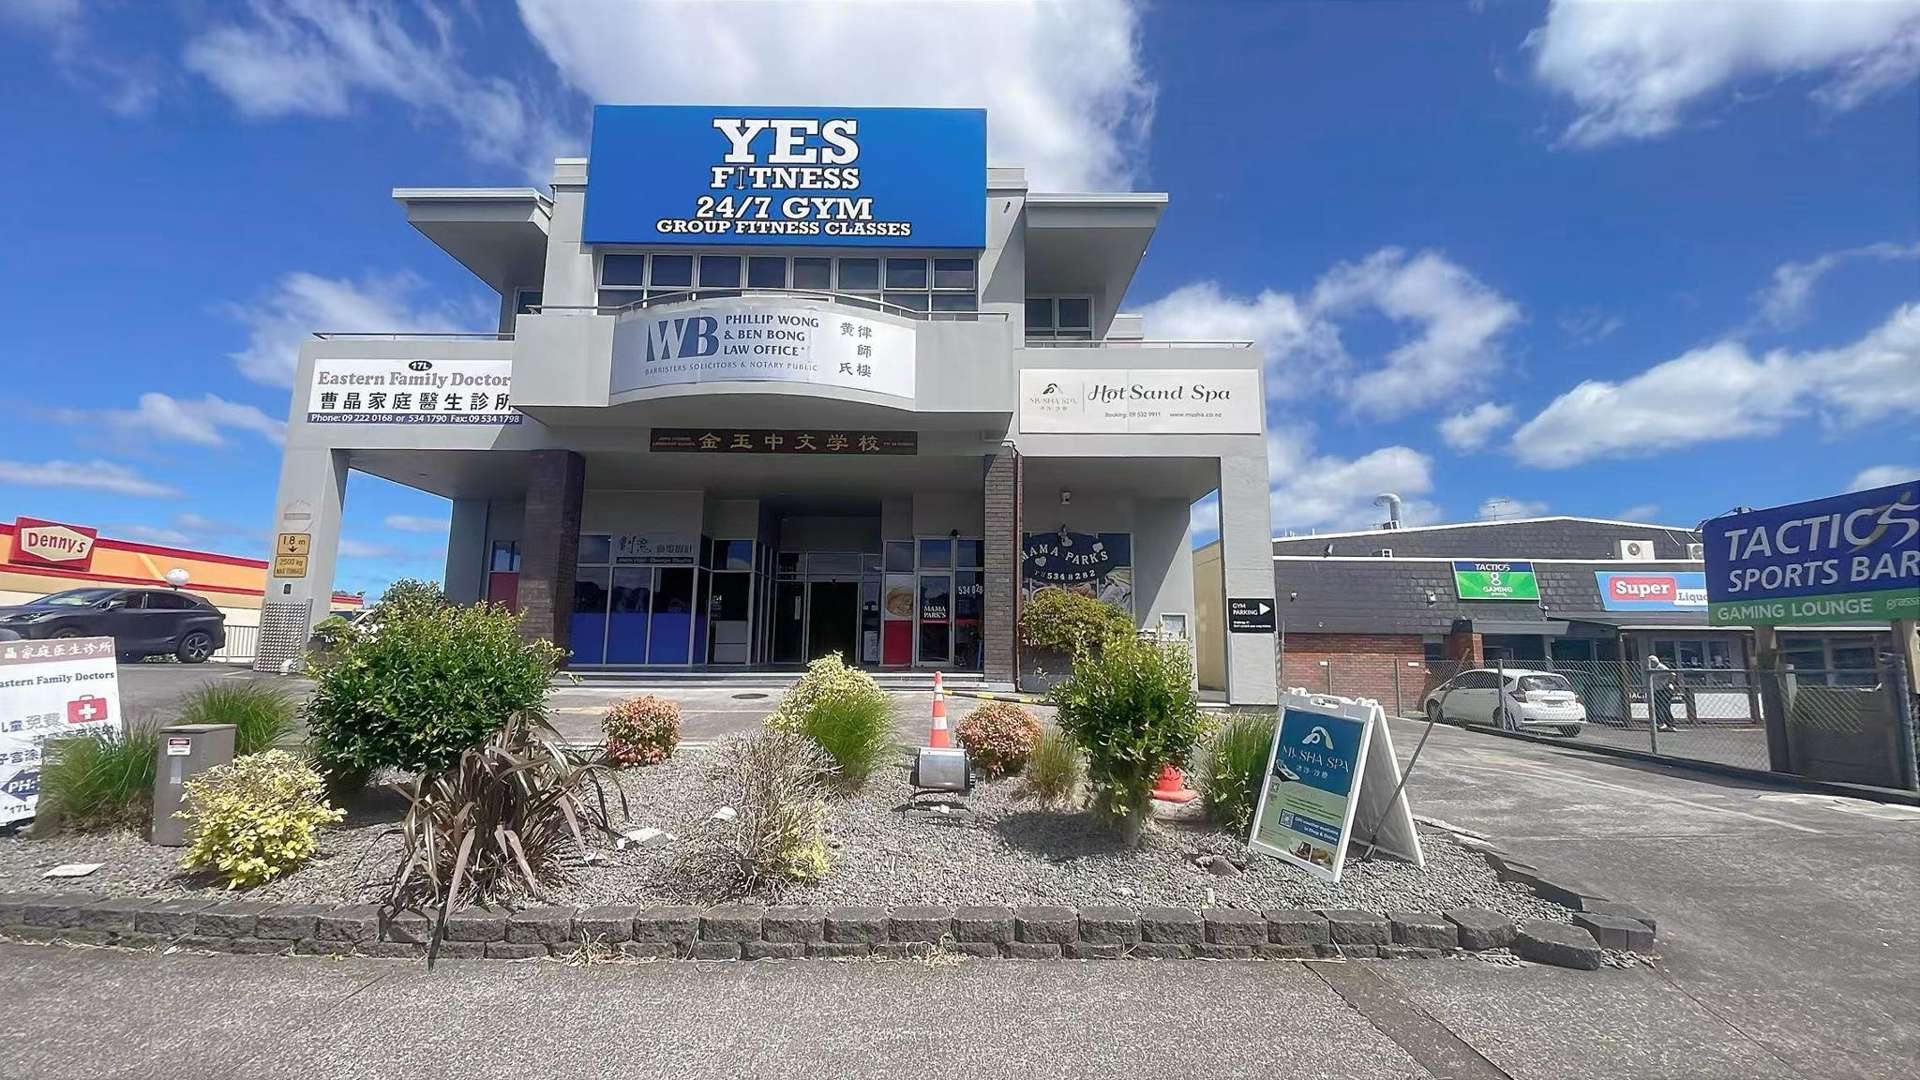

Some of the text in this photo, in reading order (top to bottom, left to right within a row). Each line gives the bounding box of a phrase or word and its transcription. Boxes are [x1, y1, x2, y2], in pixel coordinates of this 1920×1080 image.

[713, 118, 859, 165] YES
[711, 167, 860, 190] FITNESS
[696, 196, 873, 220] 24/7 GYM
[656, 219, 911, 236] GROUP FITNESS CLASSES
[725, 315, 819, 328] PHILLIP WONG
[646, 316, 719, 362] WB
[724, 330, 805, 341] & BEN BONG
[724, 345, 799, 356] LAW OFFICE
[410, 361, 430, 371] 17L
[645, 366, 686, 375] BARRISTERS
[689, 362, 737, 370] SOLICITORS
[750, 361, 784, 369] NOTARY
[787, 362, 818, 371] PUBLIC
[318, 371, 512, 389] Eastern Family Doctor
[1088, 384, 1231, 403] Hot Sand Spa
[311, 413, 341, 422] Phone:
[342, 414, 353, 422] 09
[354, 414, 370, 422] 222
[372, 414, 393, 423] 0168
[408, 414, 424, 423] 534
[427, 414, 447, 423] 1790
[450, 414, 468, 423] Fax:
[469, 415, 480, 423] 09
[481, 415, 496, 423] 534
[1728, 550, 1920, 593] SPORTS BAR
[1615, 580, 1670, 598] Super
[1718, 604, 1785, 621] GAMING
[1792, 598, 1873, 616] LOUNGE
[36, 674, 72, 687] Family
[75, 670, 115, 682] Doctors
